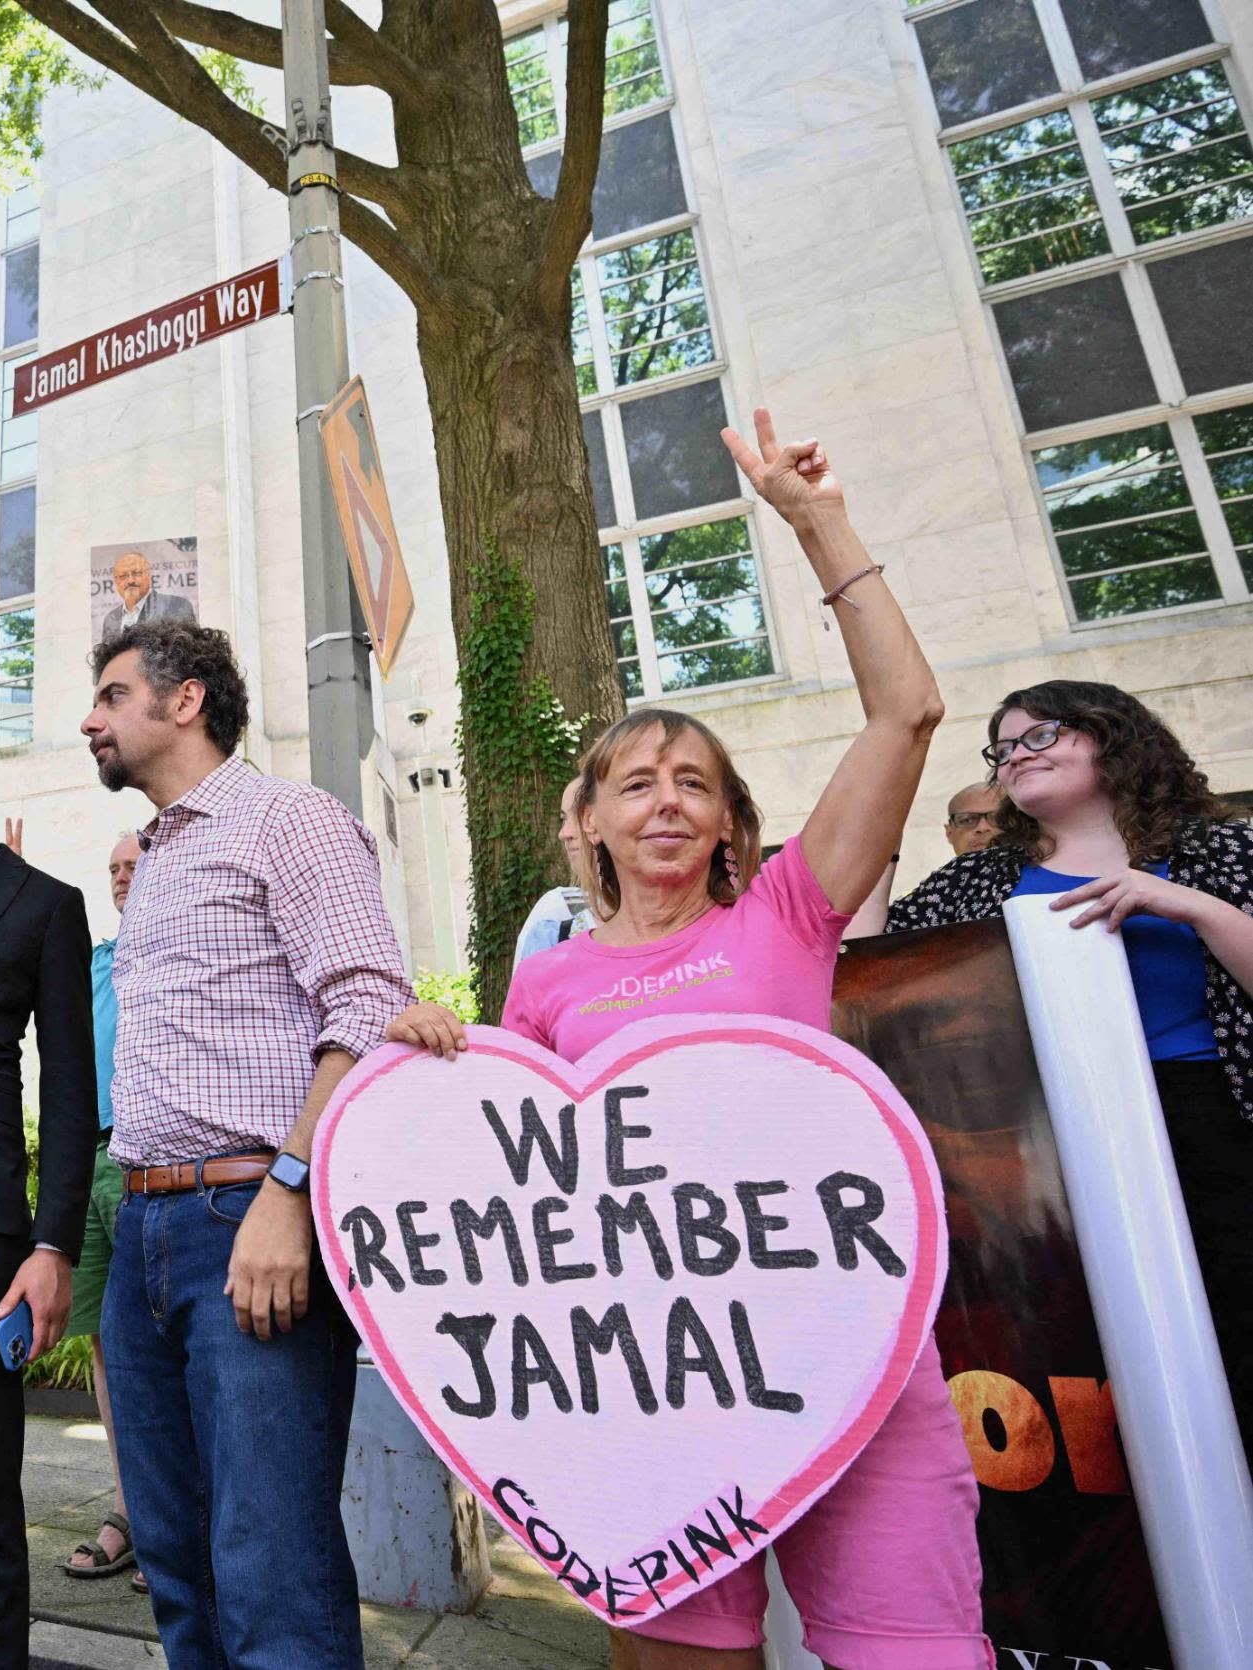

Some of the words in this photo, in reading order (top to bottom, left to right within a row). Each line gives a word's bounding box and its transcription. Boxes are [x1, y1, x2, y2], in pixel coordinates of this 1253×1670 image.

[24, 345, 86, 403] Jamal
[96, 295, 207, 374] Khashoggi
[216, 280, 265, 325] Way
[579, 998, 645, 1016] WOMEN
[650, 986, 680, 1001] FOR
[481, 1085, 668, 1194] WE
[340, 1171, 907, 1292] REMEMBER
[435, 1297, 805, 1420] JAMAL
[492, 1477, 769, 1620] CODEPINK
